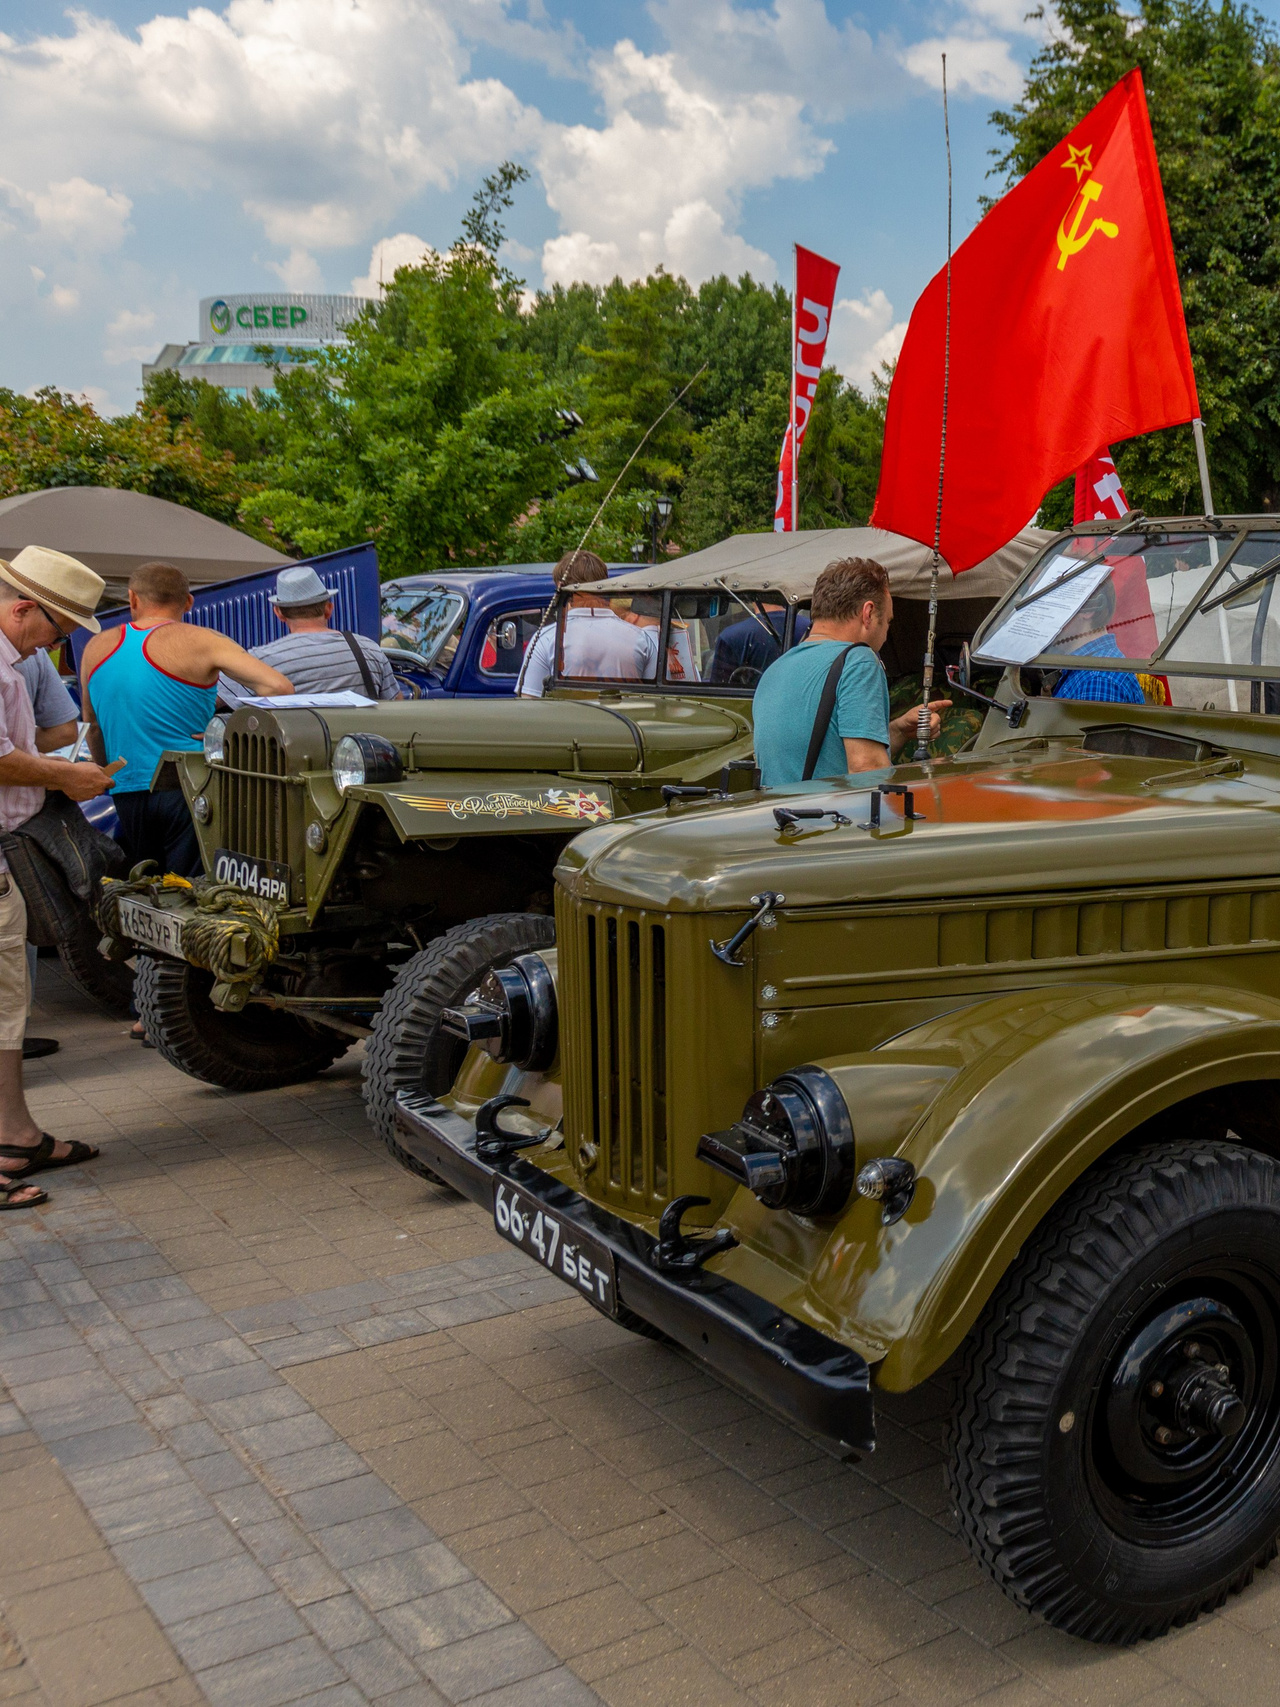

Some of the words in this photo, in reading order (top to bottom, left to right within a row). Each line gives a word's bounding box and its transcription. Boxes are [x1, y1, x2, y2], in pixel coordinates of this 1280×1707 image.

[236, 305, 307, 329] СБЕР
[495, 1183, 560, 1267] 66-47
[563, 1243, 610, 1302] БЕТ
